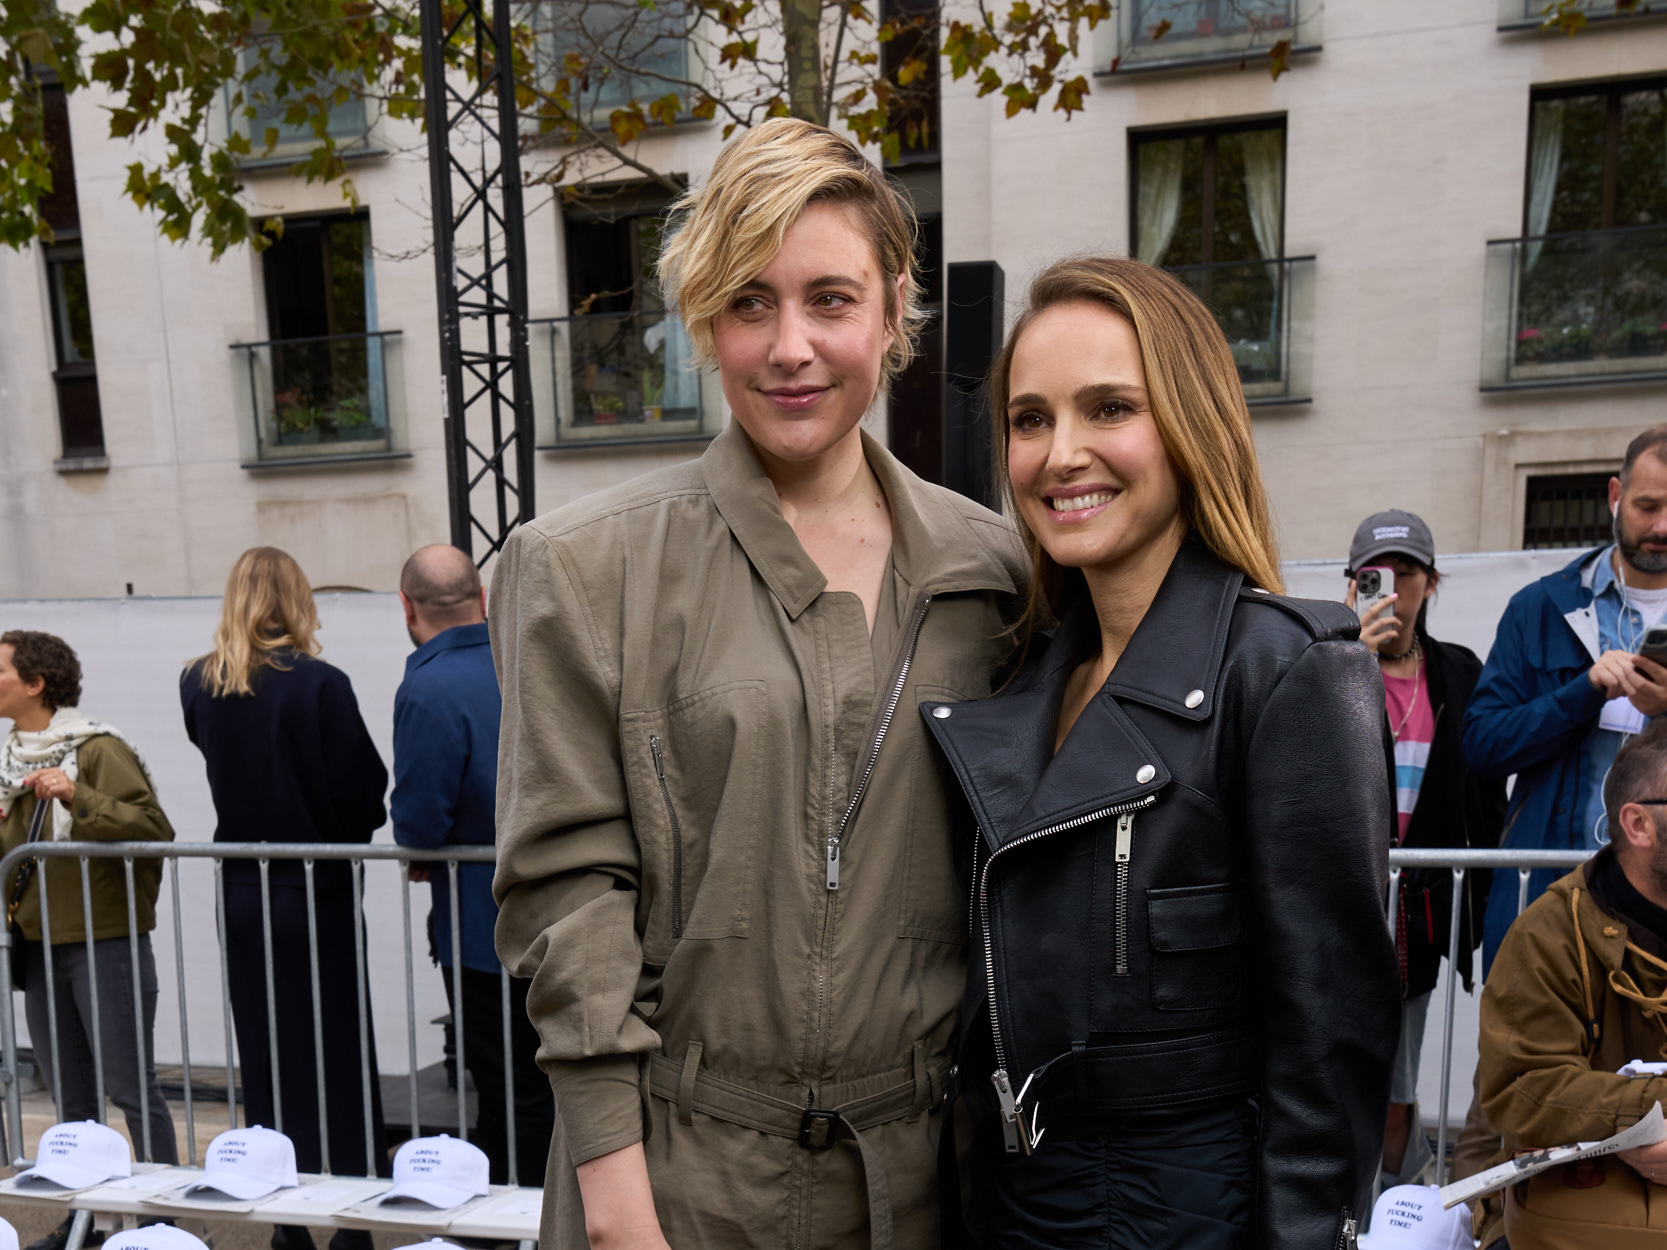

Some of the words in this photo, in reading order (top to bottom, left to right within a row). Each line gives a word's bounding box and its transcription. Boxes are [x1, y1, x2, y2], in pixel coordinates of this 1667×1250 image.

[48, 1140, 79, 1148] FUCKING
[1394, 1200, 1423, 1211] ABOUT
[1387, 1208, 1423, 1222] FUCKING
[1389, 1219, 1412, 1230] TIME!
